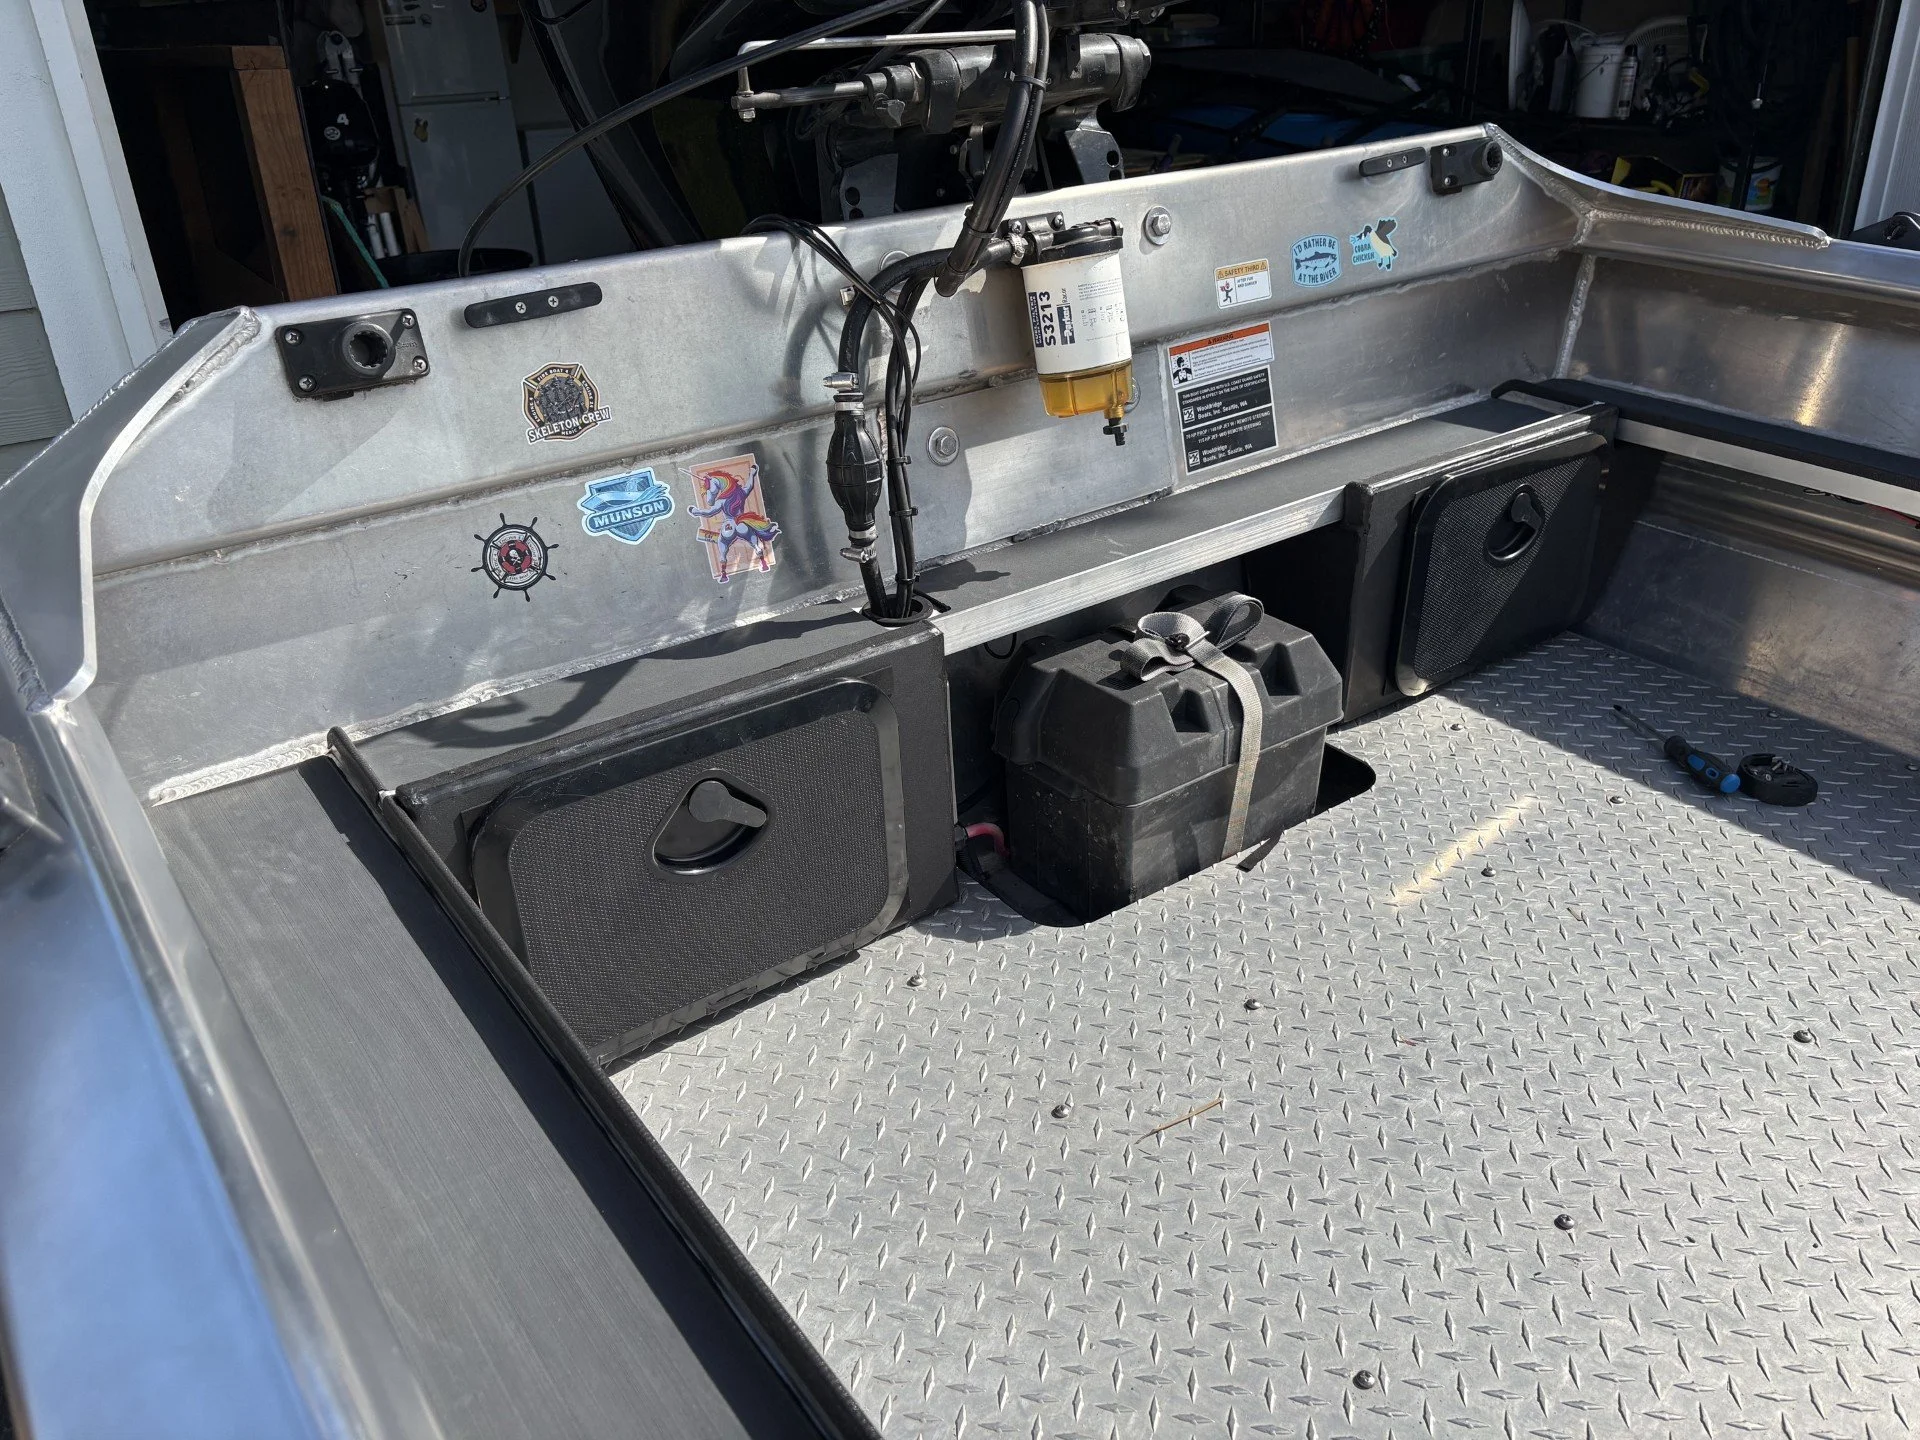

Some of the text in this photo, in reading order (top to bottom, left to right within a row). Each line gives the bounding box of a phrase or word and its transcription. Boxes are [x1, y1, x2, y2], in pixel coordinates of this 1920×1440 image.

[336, 113, 349, 125] 4
[1294, 238, 1336, 256] I'D RATHER BE
[1354, 243, 1371, 253] COBRA
[1353, 252, 1374, 263] CHICKEN
[1224, 264, 1260, 277] SAFETY THIRD
[1298, 267, 1337, 284] AT THE RIVER
[1039, 291, 1056, 346] S3213
[1062, 306, 1072, 337] Parker
[1197, 401, 1222, 412] Wooldridge
[528, 408, 610, 442] SKELETON CREW
[1202, 445, 1227, 456] Wooldridge
[592, 502, 665, 530] MUNSON
